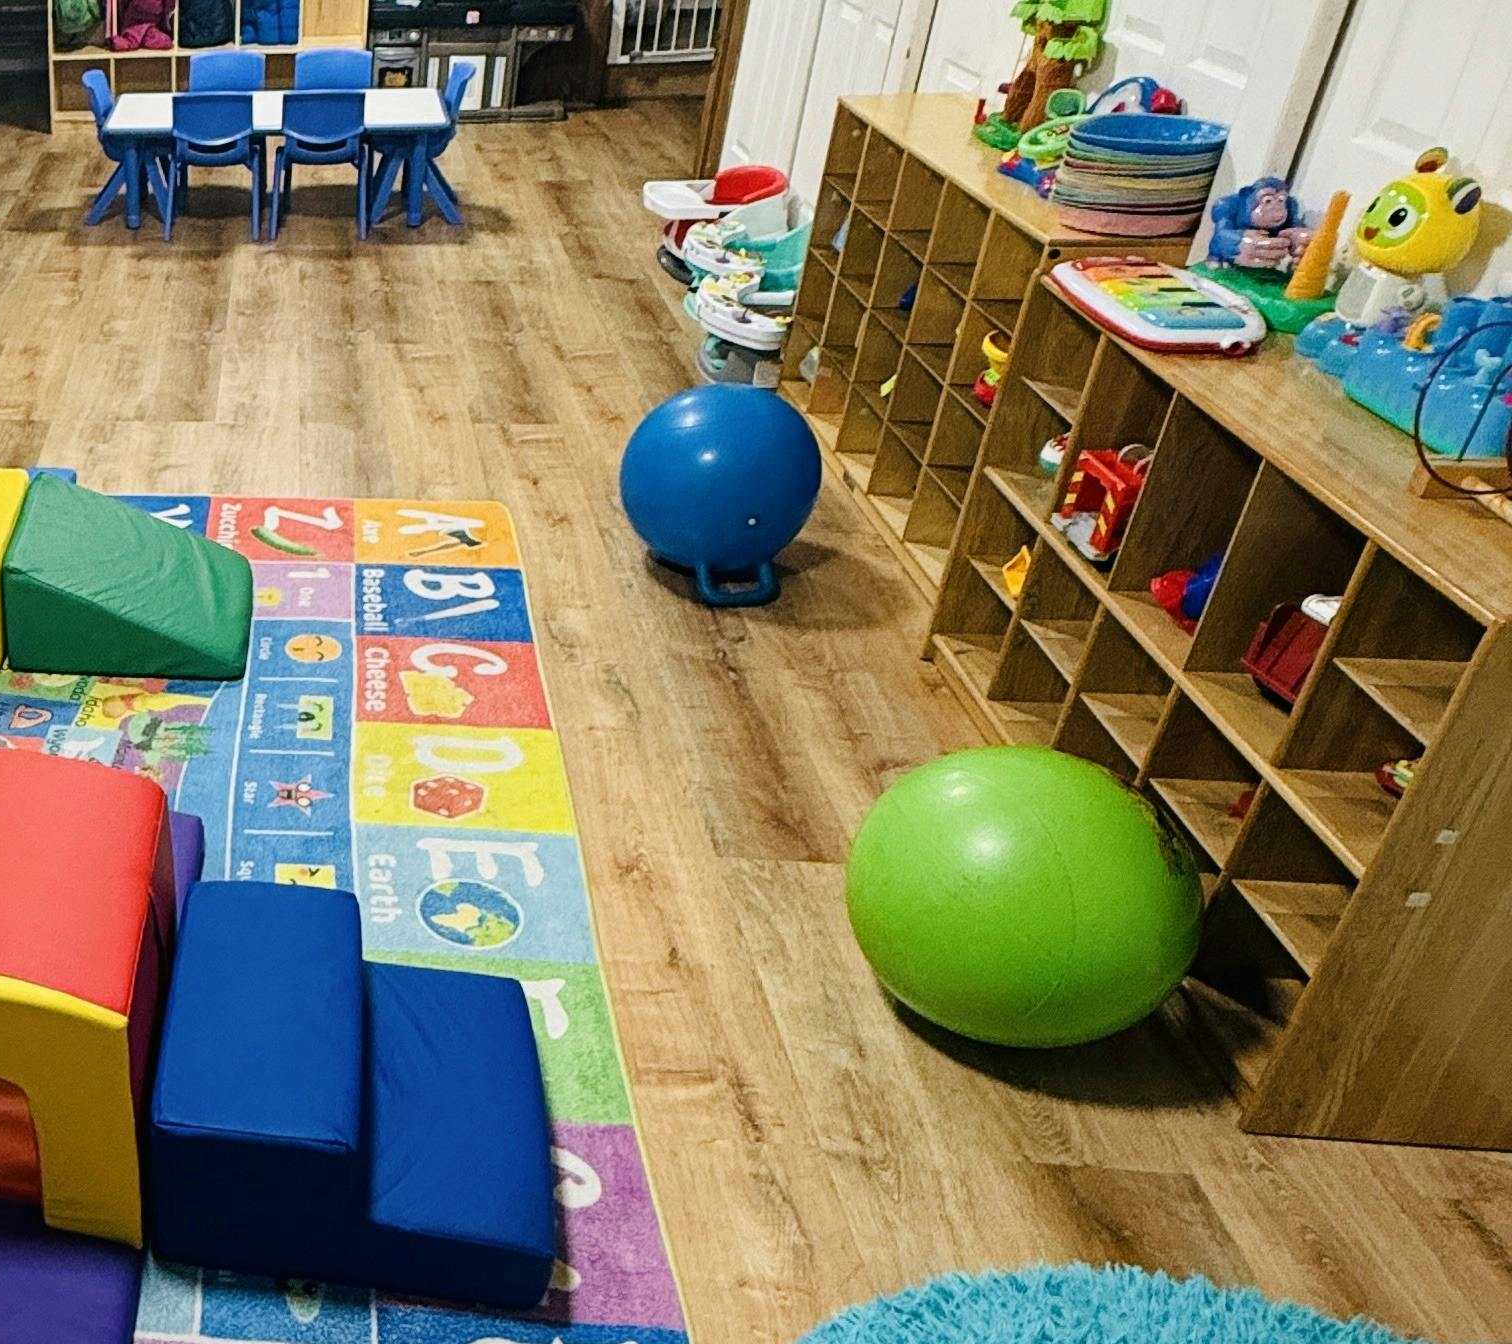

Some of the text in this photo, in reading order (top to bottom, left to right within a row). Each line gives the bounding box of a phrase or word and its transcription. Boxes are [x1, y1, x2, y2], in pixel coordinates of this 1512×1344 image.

[260, 504, 345, 534] Z
[361, 519, 382, 545] Axe
[395, 507, 483, 546] A
[361, 567, 388, 634] Baseball
[403, 568, 498, 600] B
[364, 646, 388, 714] Cheese
[409, 643, 509, 680] C
[410, 735, 526, 776] D
[361, 753, 388, 800] Dice
[415, 836, 546, 889] E
[367, 852, 403, 925] Earth
